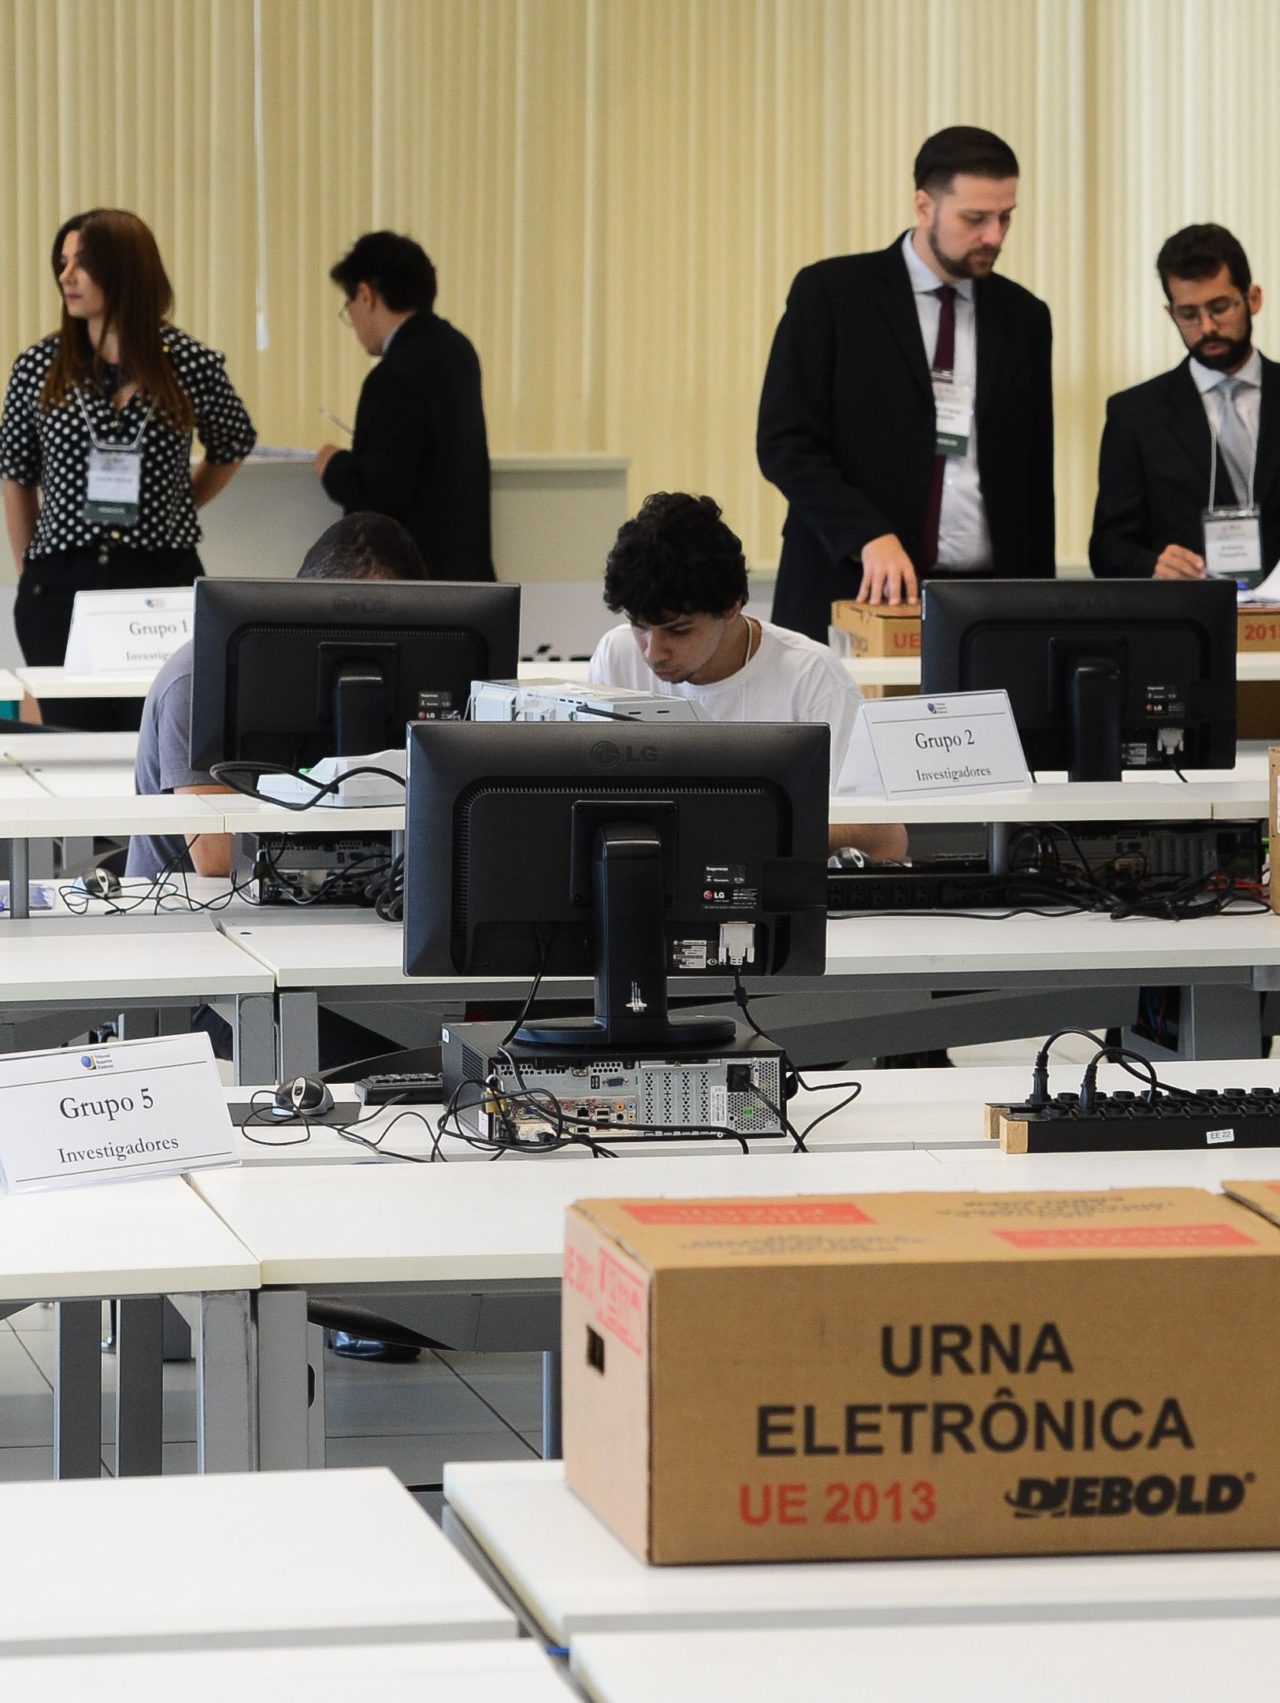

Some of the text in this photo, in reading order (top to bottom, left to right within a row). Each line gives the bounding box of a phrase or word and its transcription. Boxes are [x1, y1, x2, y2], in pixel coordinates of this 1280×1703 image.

[129, 619, 188, 639] Grupo 1
[894, 632, 920, 649] UE
[126, 651, 171, 662] Investig
[915, 729, 975, 752] Grupo 2
[626, 745, 659, 765] LG
[916, 766, 991, 782] Investigadores
[60, 1088, 154, 1121] Grupo 5
[58, 1137, 179, 1164] Investigadores
[881, 1322, 1074, 1377] URNA
[757, 1387, 1196, 1457] ELETRÔNICA
[739, 1480, 938, 1527] UE 2013
[1004, 1472, 1246, 1520] DIEBOLD
